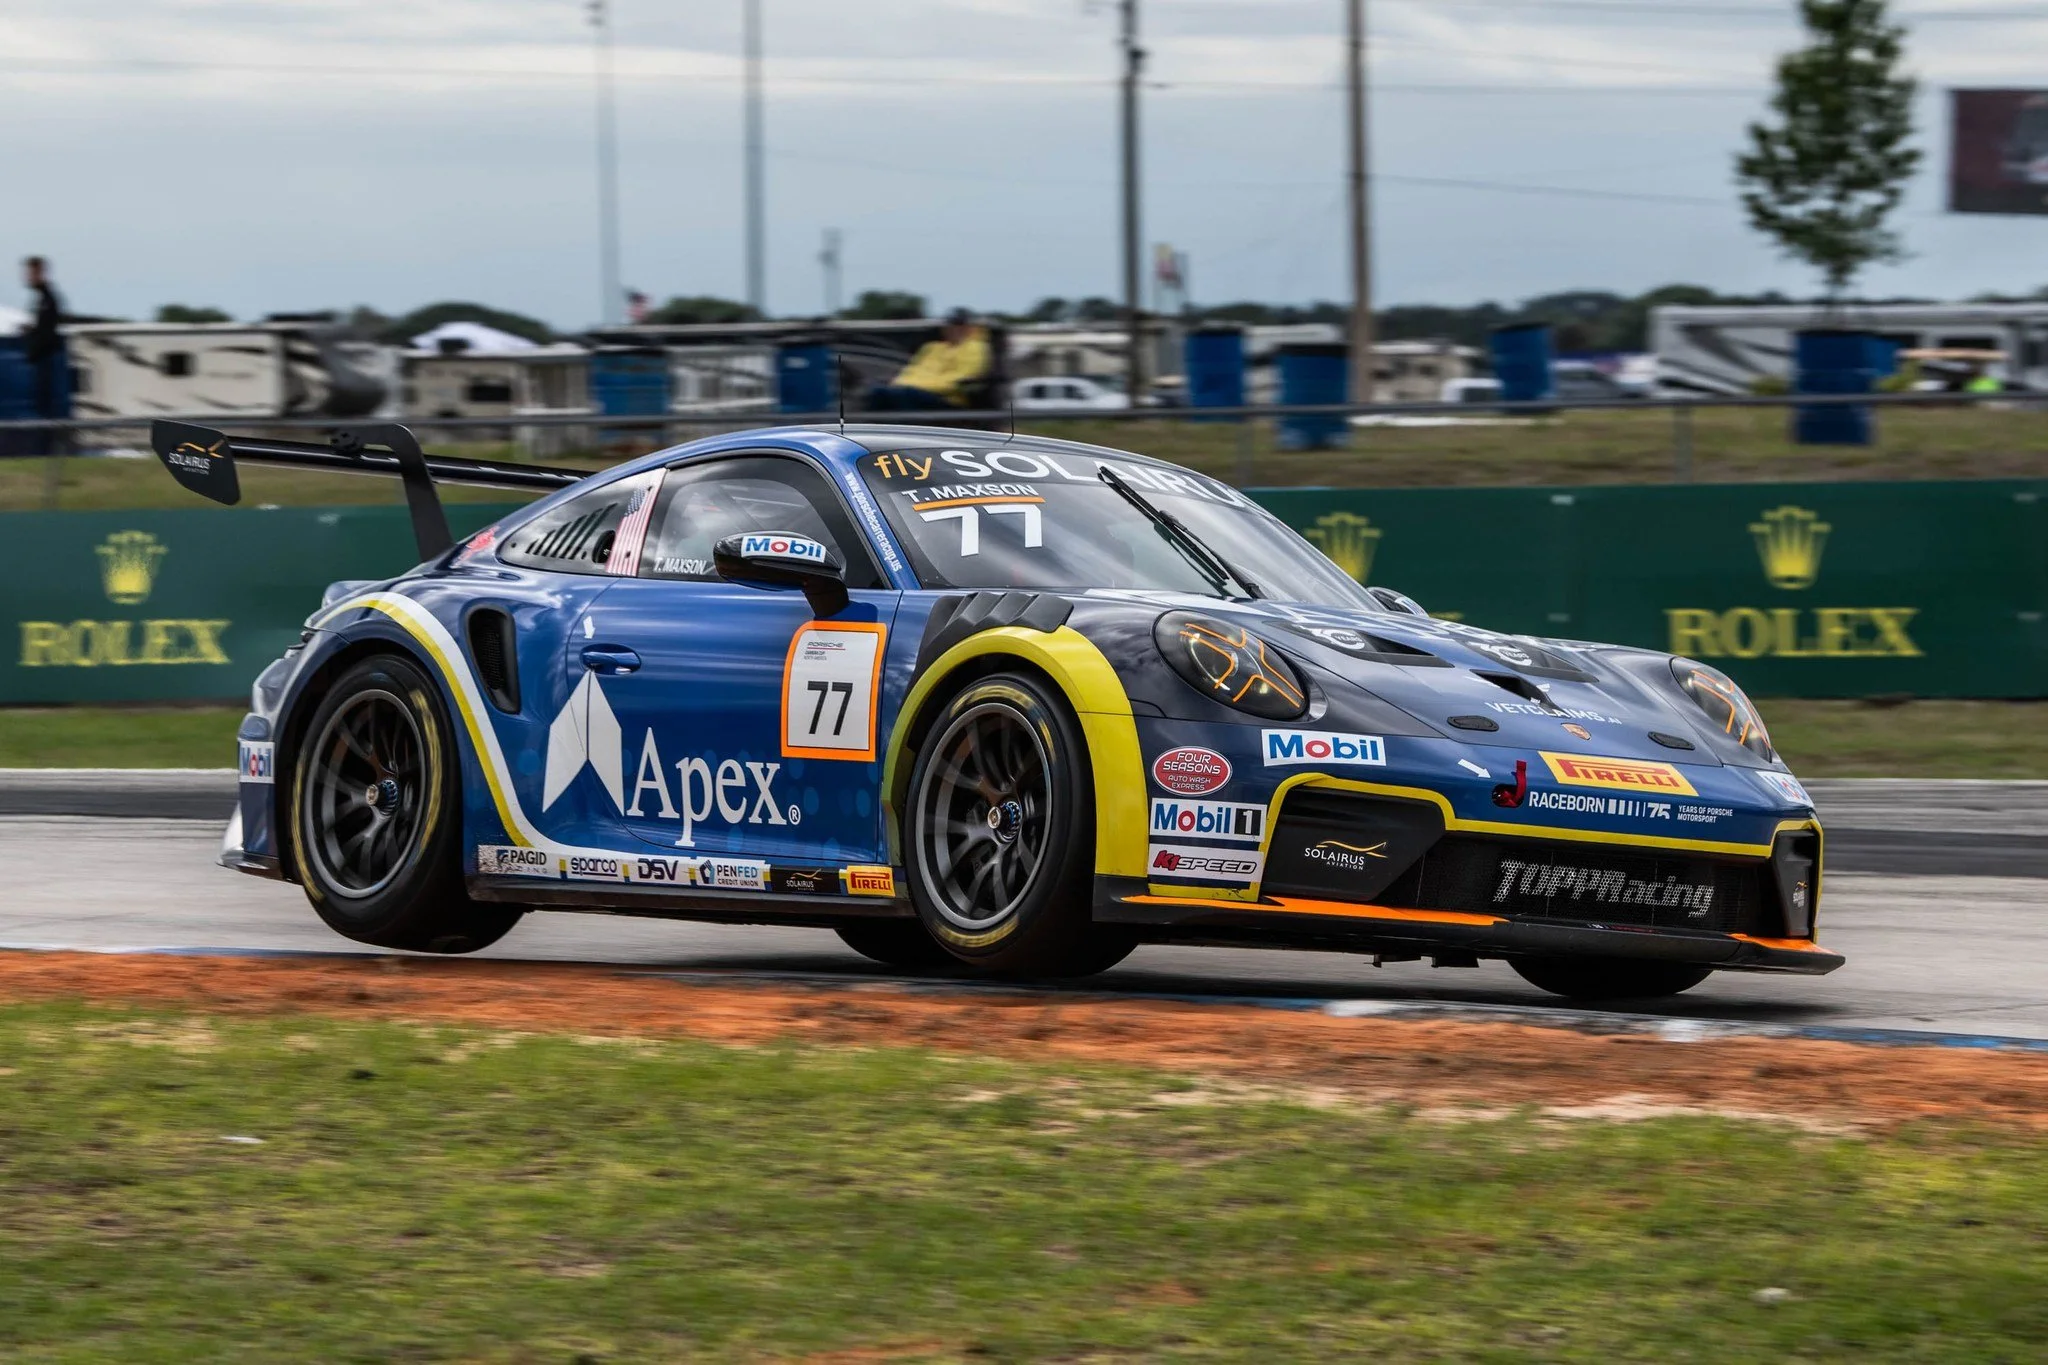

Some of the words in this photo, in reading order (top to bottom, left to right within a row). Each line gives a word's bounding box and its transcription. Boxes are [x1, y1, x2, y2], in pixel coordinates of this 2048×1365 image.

[874, 454, 932, 480] fly
[902, 488, 929, 503] T.
[934, 484, 1039, 501] MAXSON
[919, 504, 1042, 557] 77
[745, 537, 822, 559] Mobil
[664, 558, 708, 575] MAXSON
[1663, 606, 1926, 658] ROLEX
[18, 619, 232, 666] ROLEX
[807, 680, 854, 736] 77
[1268, 733, 1380, 761] Mobil
[1176, 752, 1212, 764] FOUR
[1163, 761, 1221, 775] SEASONS
[1555, 758, 1681, 788] PIRELLI
[1168, 774, 1188, 783] AUTO
[1189, 776, 1212, 784] WASH
[1171, 782, 1206, 791] EXPRESS
[1528, 791, 1605, 814] RACEBORN
[1647, 802, 1671, 820] 75
[1678, 805, 1698, 814] YEARS
[1699, 807, 1706, 815] OF
[1707, 807, 1734, 817] PORSCHE
[1154, 803, 1232, 834] Mobil
[1677, 813, 1717, 824] MOTORSPORT
[510, 849, 547, 866] PAGID
[1304, 847, 1365, 866] SOLAIRUS
[1326, 861, 1364, 871] AVIATION
[571, 857, 617, 876] sparco
[637, 857, 679, 881] DSV
[716, 864, 758, 879] PENFED
[717, 878, 738, 886] CREDIT
[850, 871, 891, 891] PIRELLI
